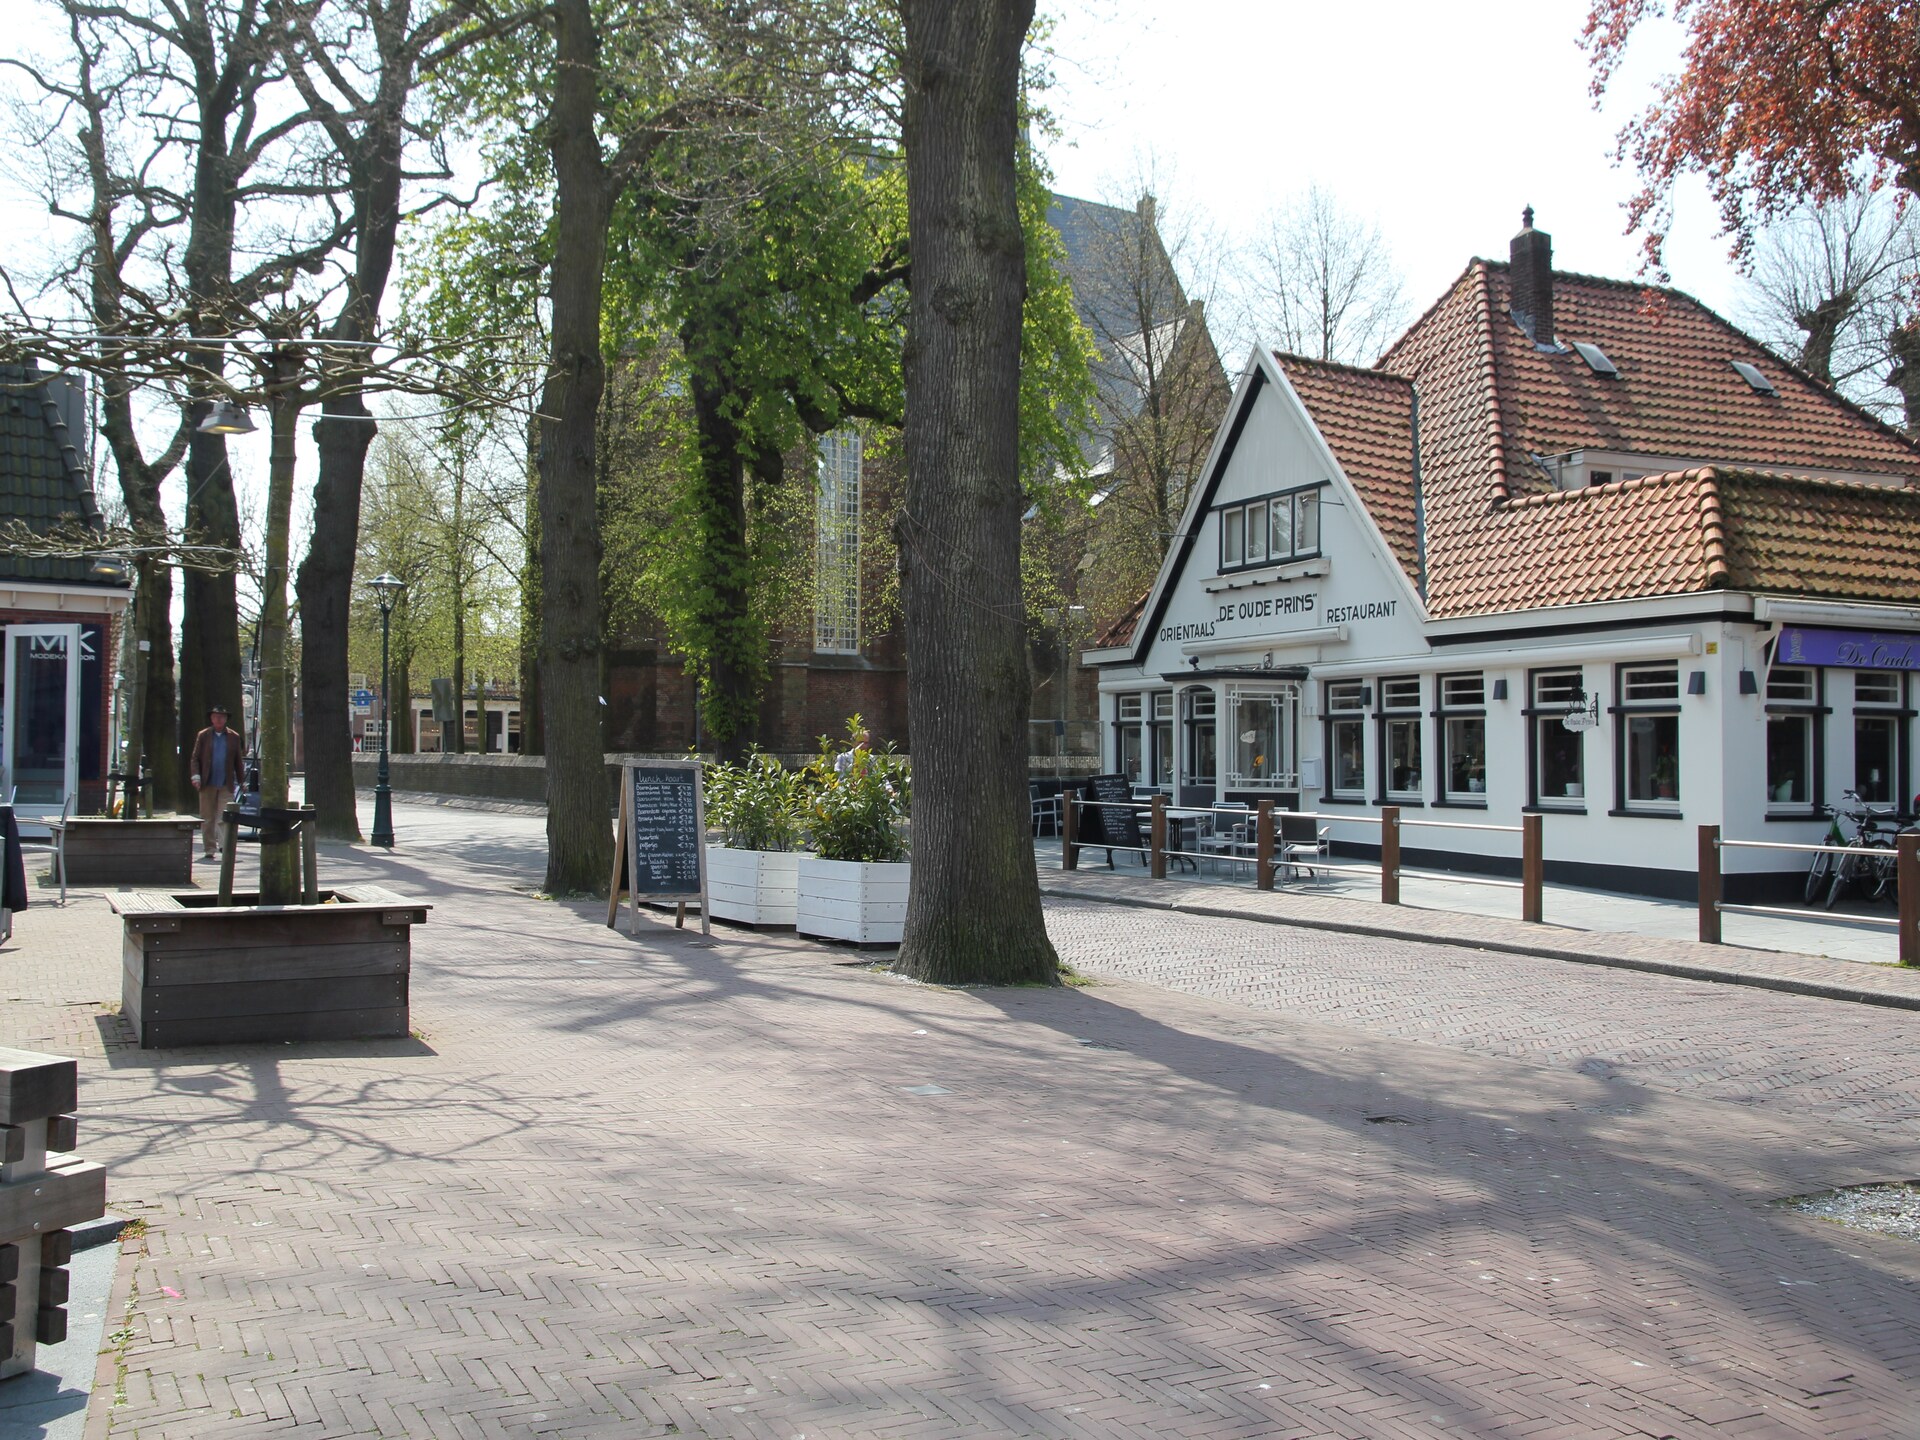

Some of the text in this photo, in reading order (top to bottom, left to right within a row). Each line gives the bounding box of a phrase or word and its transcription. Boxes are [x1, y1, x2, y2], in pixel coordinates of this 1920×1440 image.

[1160, 621, 1215, 642] ORIËNTAALS
[1238, 599, 1273, 620] OUDE
[1326, 600, 1397, 623] RESTAURANT
[1835, 641, 1914, 668] De Oude
